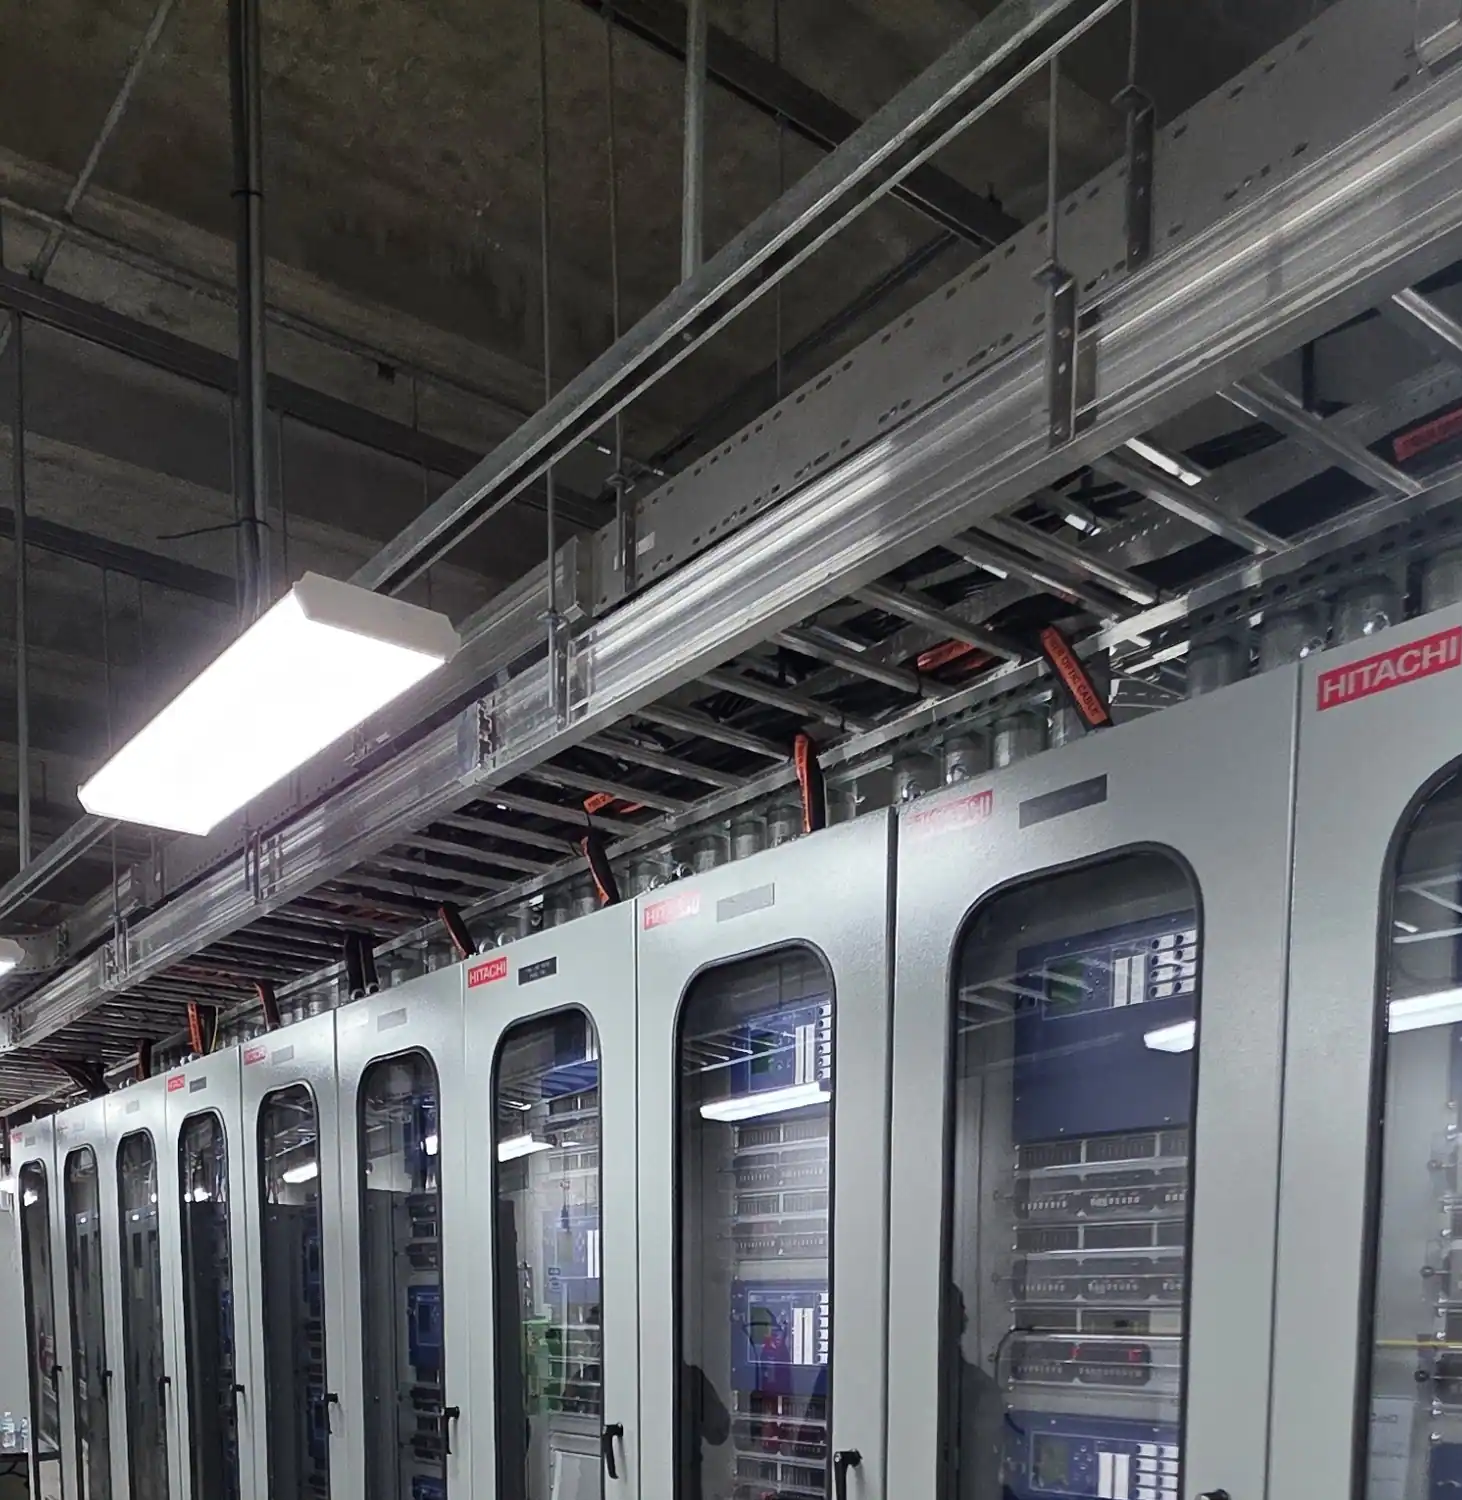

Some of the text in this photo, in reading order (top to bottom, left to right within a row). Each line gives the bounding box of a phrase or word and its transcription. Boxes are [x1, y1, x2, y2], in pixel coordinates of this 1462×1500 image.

[1321, 634, 1458, 704] HITACHI
[1077, 684, 1100, 717] CABLE
[469, 960, 507, 985] HITACHI
